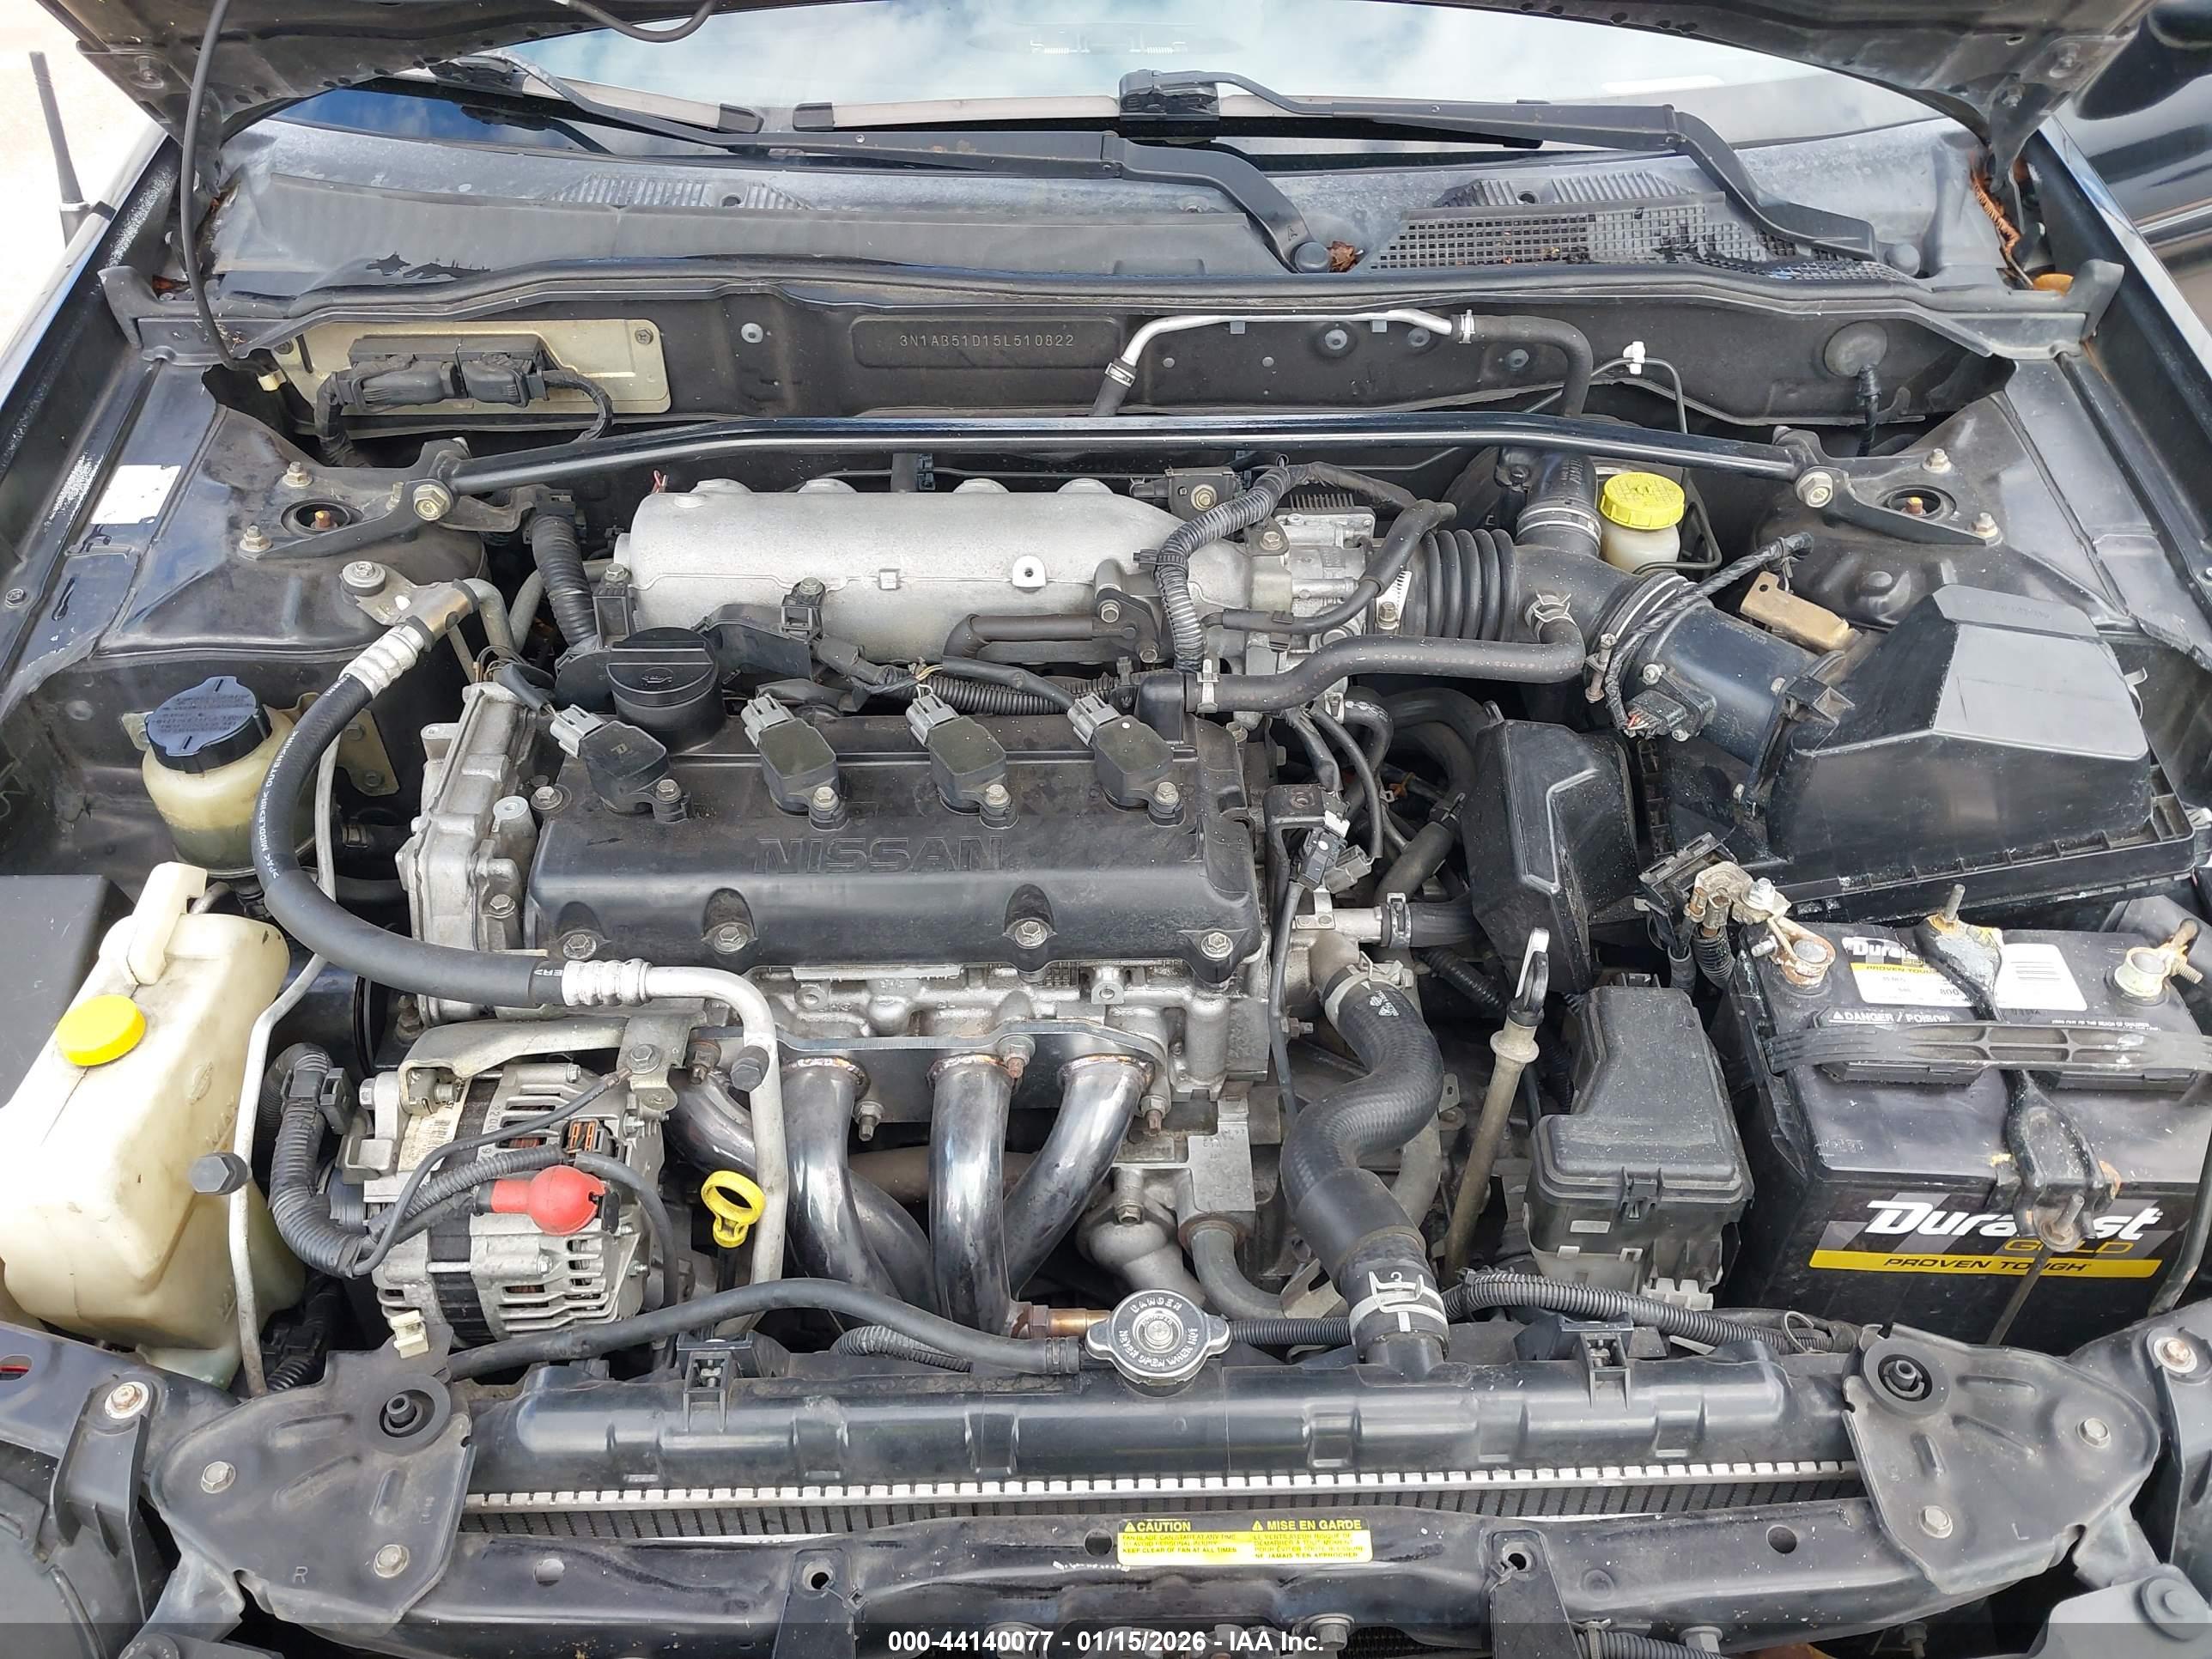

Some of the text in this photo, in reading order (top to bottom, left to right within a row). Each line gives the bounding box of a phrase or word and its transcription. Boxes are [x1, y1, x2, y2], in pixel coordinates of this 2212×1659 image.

[899, 334, 1074, 348] 3N1AB51D15L510822
[753, 836, 1003, 875] NISSAN
[1844, 1012, 1894, 1022] DANGER
[1905, 1013, 1951, 1024] POISON
[1864, 1200, 2162, 1240] Durast
[2004, 1239, 2134, 1254] GLD
[1883, 1258, 1991, 1268] PROVEN
[1129, 1297, 1182, 1314] DANGER
[1119, 1328, 1199, 1367] NEVER OPEN WHEN HOT
[1137, 1522, 1192, 1532] CAUTION
[1267, 1519, 1362, 1530] MISE EN GARDE
[292, 1565, 308, 1583] R
